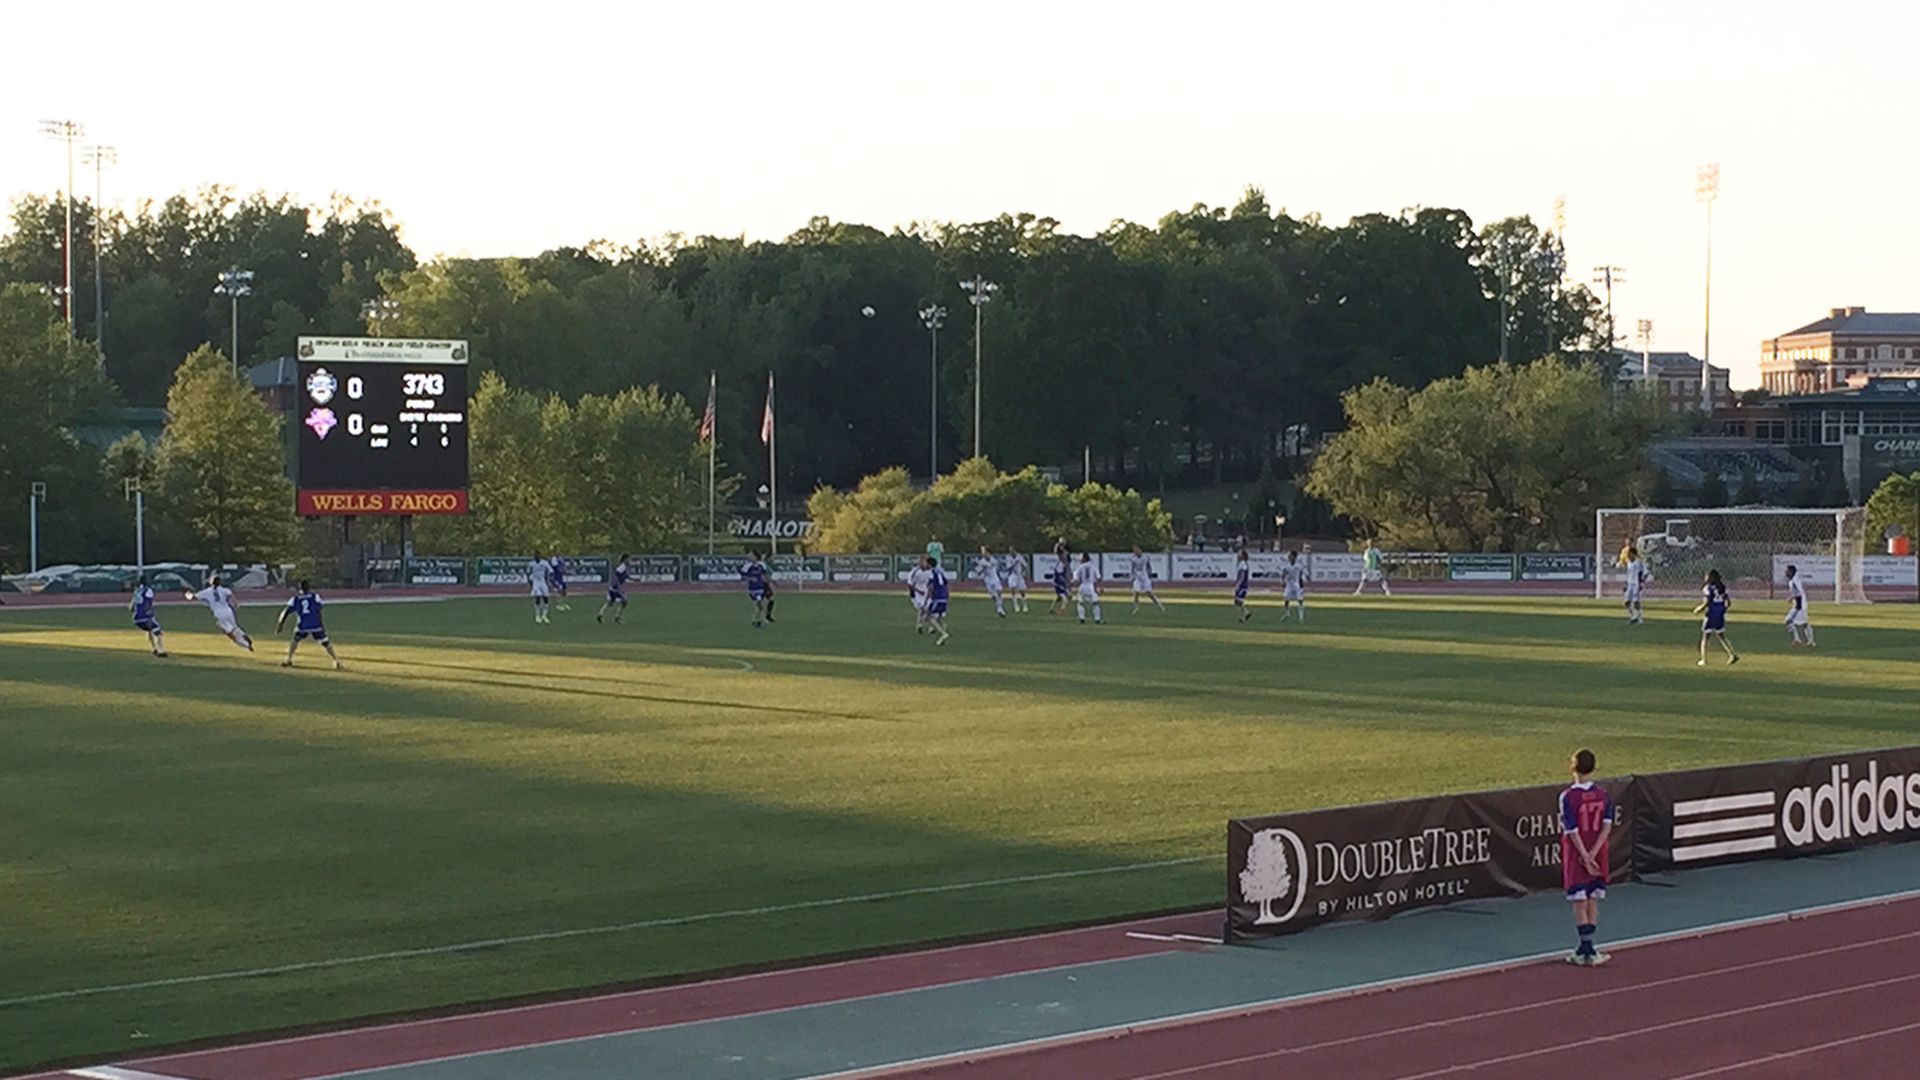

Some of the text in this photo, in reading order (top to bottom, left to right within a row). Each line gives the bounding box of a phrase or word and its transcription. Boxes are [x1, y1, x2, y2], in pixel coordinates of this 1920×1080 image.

[347, 377, 363, 399] 0
[347, 413, 364, 435] 0
[312, 494, 457, 511] WELLS FARGO
[301, 599, 310, 614] 2
[1579, 801, 1604, 831] 17
[1315, 827, 1492, 887] DOUBLETREE
[1318, 900, 1339, 917] BY
[1346, 887, 1409, 911] HILTON
